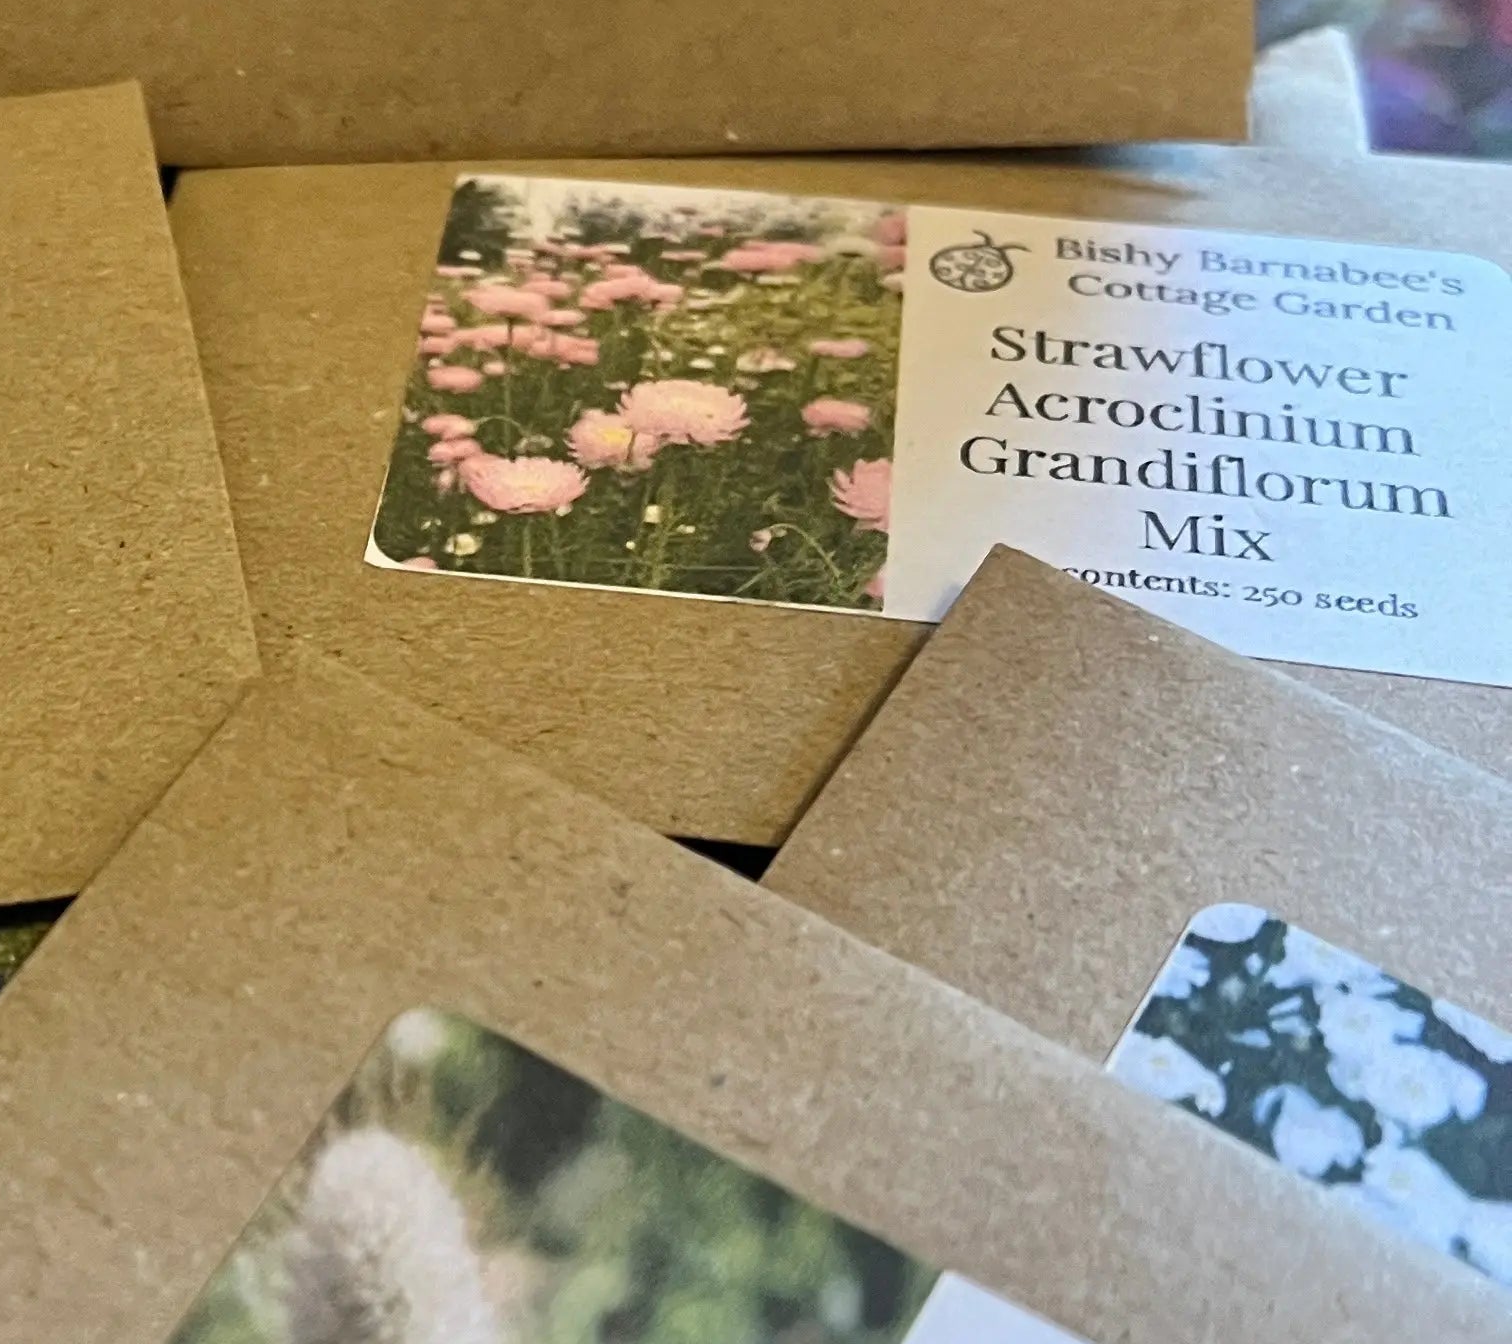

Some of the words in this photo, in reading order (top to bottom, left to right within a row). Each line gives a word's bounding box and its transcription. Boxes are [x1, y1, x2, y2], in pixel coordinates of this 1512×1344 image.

[1055, 236, 1182, 273] Bishy
[1198, 249, 1465, 297] Barnabee's
[1068, 274, 1262, 316] Cottage
[1273, 290, 1456, 332] Garden
[989, 325, 1409, 400] Strawflower
[984, 382, 1421, 457] Acroclinium
[959, 436, 1453, 518] Grandiflorum
[1138, 510, 1274, 562] Mix
[1243, 583, 1303, 608] 250
[1314, 592, 1419, 620] seeds
